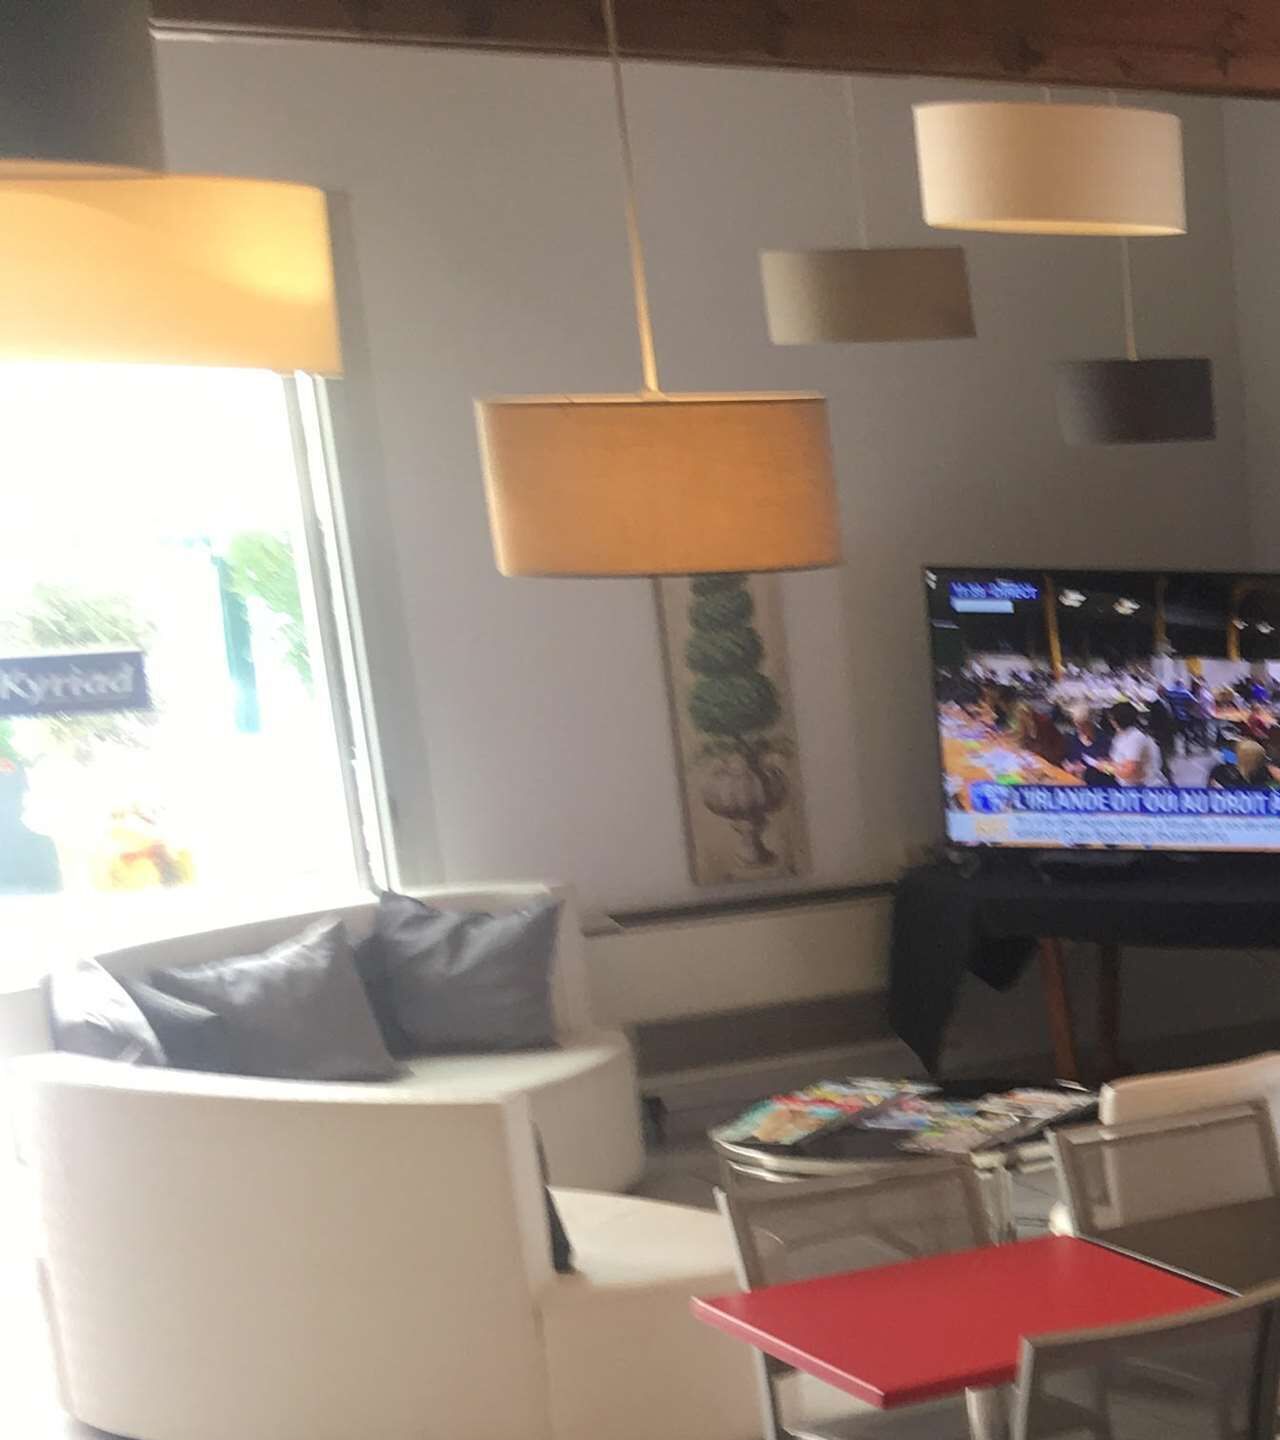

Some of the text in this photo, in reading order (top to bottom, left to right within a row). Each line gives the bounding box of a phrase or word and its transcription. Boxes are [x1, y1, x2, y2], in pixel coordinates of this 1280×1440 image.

[0, 662, 134, 704] Kyriad
[1143, 788, 1178, 814] OUI
[1179, 789, 1209, 814] AU
[1209, 790, 1267, 815] DROIT
